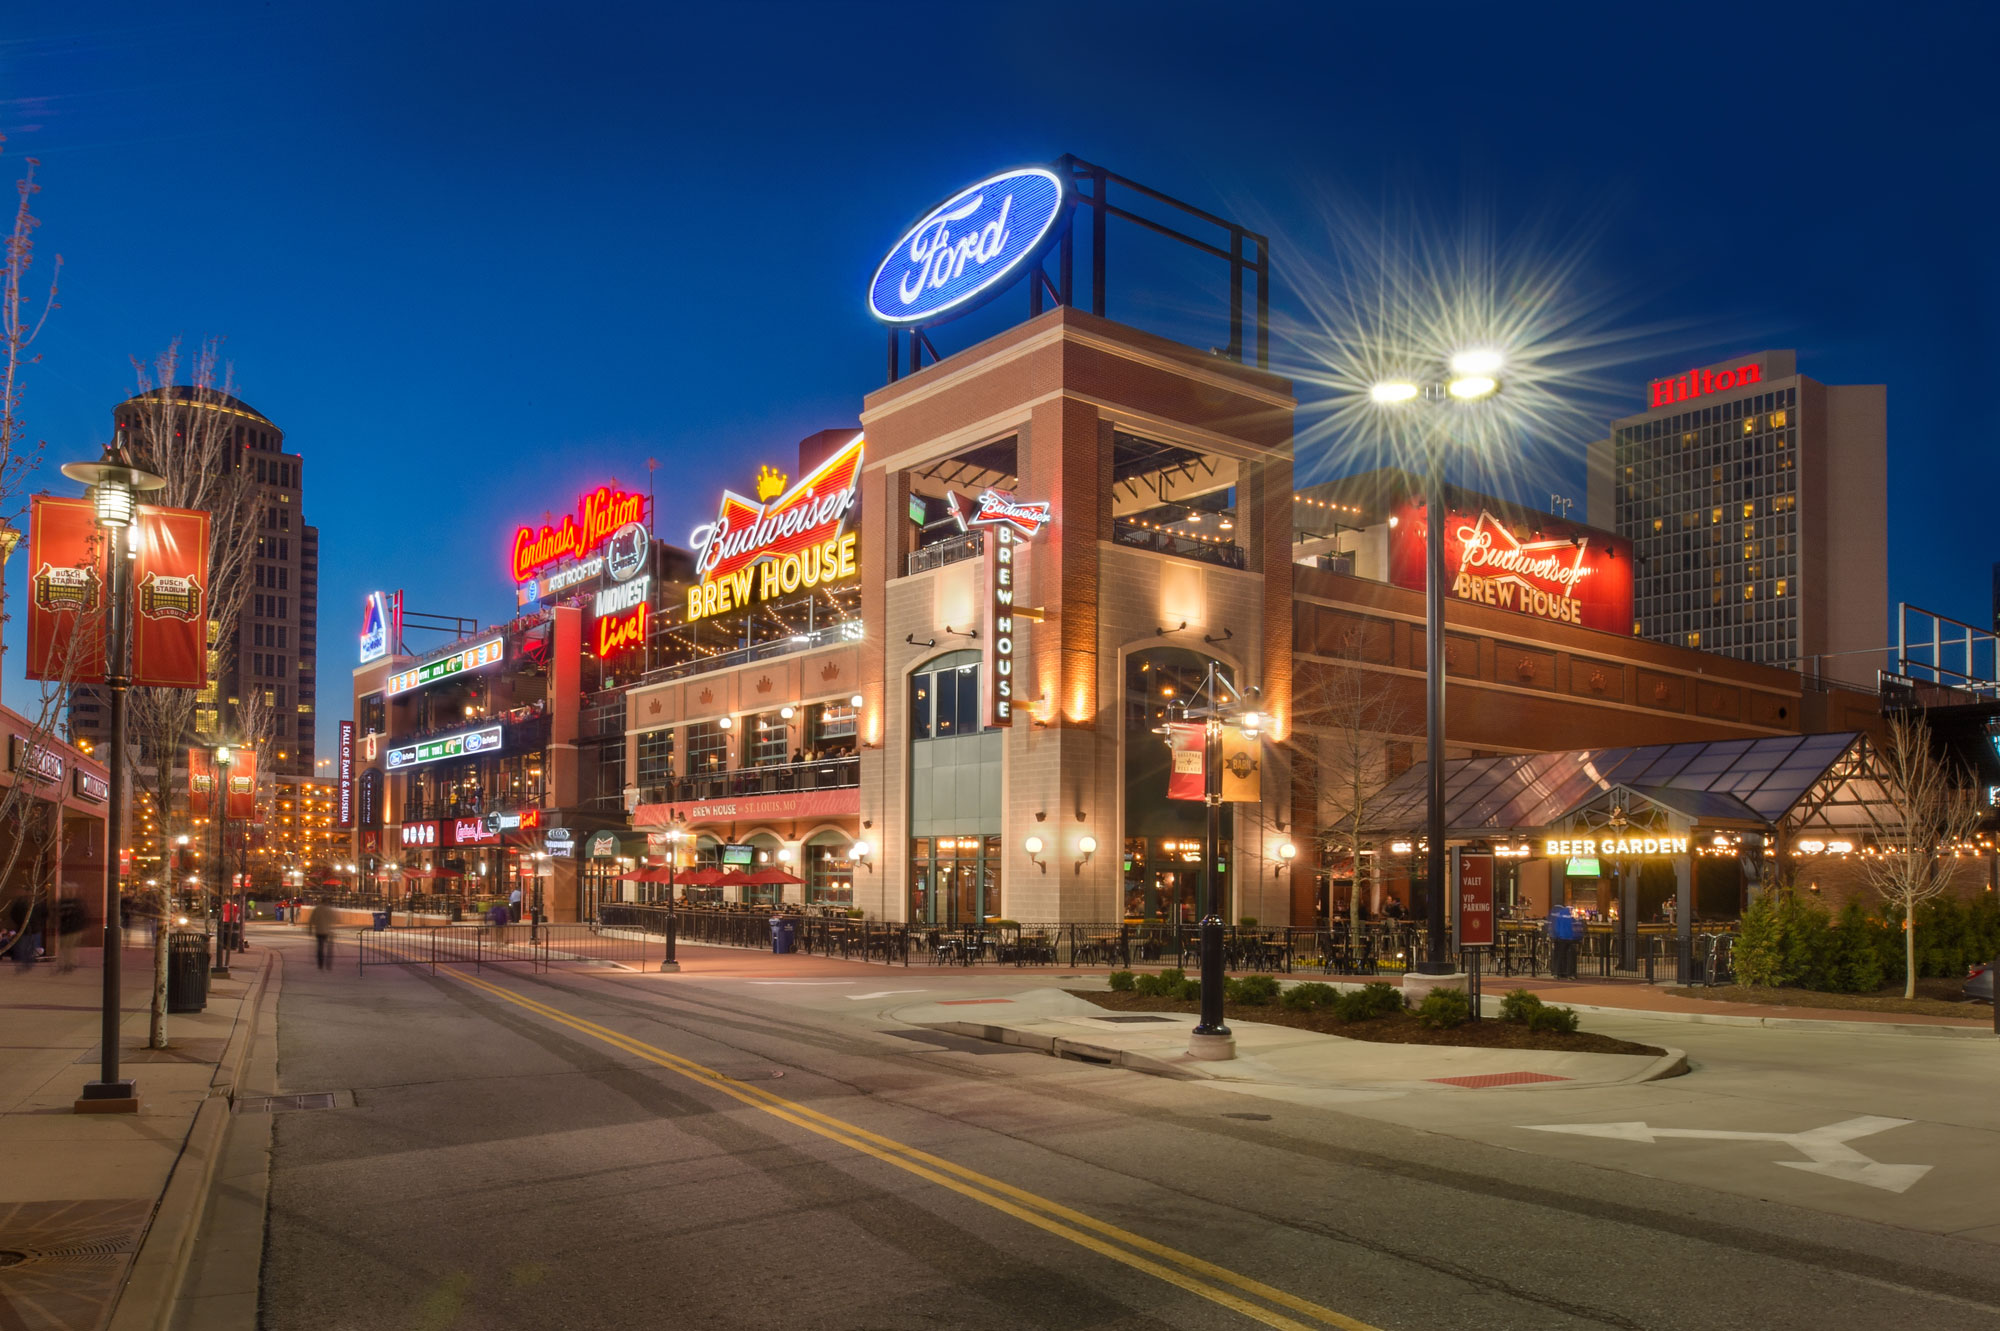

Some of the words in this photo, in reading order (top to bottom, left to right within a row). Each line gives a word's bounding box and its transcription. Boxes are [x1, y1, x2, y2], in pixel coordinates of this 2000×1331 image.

[900, 193, 1012, 304] Ford
[1651, 363, 1761, 408] Hilton
[978, 495, 1051, 522] Budweiser
[514, 528, 575, 581] Cardinals
[575, 488, 639, 558] Nation
[689, 487, 855, 574] Budweiser
[998, 526, 1013, 605] BREW
[1457, 525, 1582, 584] Budweiser
[56, 570, 81, 578] BUSCH
[549, 574, 566, 592] AT&T
[566, 558, 604, 583] ROOFTOP
[688, 566, 755, 622] BREW
[761, 533, 856, 600] HOUSE
[596, 576, 650, 617] MIDWEST
[1458, 572, 1515, 608] BREW
[1520, 586, 1582, 624] HOUSE
[166, 609, 186, 618] LOUIS
[599, 602, 646, 656] Live!
[998, 617, 1013, 718] HOUSE
[342, 725, 351, 746] HALL
[342, 747, 350, 758] OF
[1232, 759, 1252, 770] BARN
[342, 759, 350, 779] FAME
[342, 780, 350, 788] &
[341, 789, 350, 823] MUSEUM
[692, 805, 711, 817] BREW
[713, 804, 737, 816] HOUSE
[744, 802, 756, 814] ST.
[757, 801, 782, 813] LOUIS,
[783, 800, 796, 811] MO
[1546, 839, 1596, 855] BEER
[1601, 837, 1687, 854] GARDEN
[1463, 877, 1482, 886] VALET
[1463, 894, 1475, 902] VIP
[1463, 903, 1490, 912] PARKING
